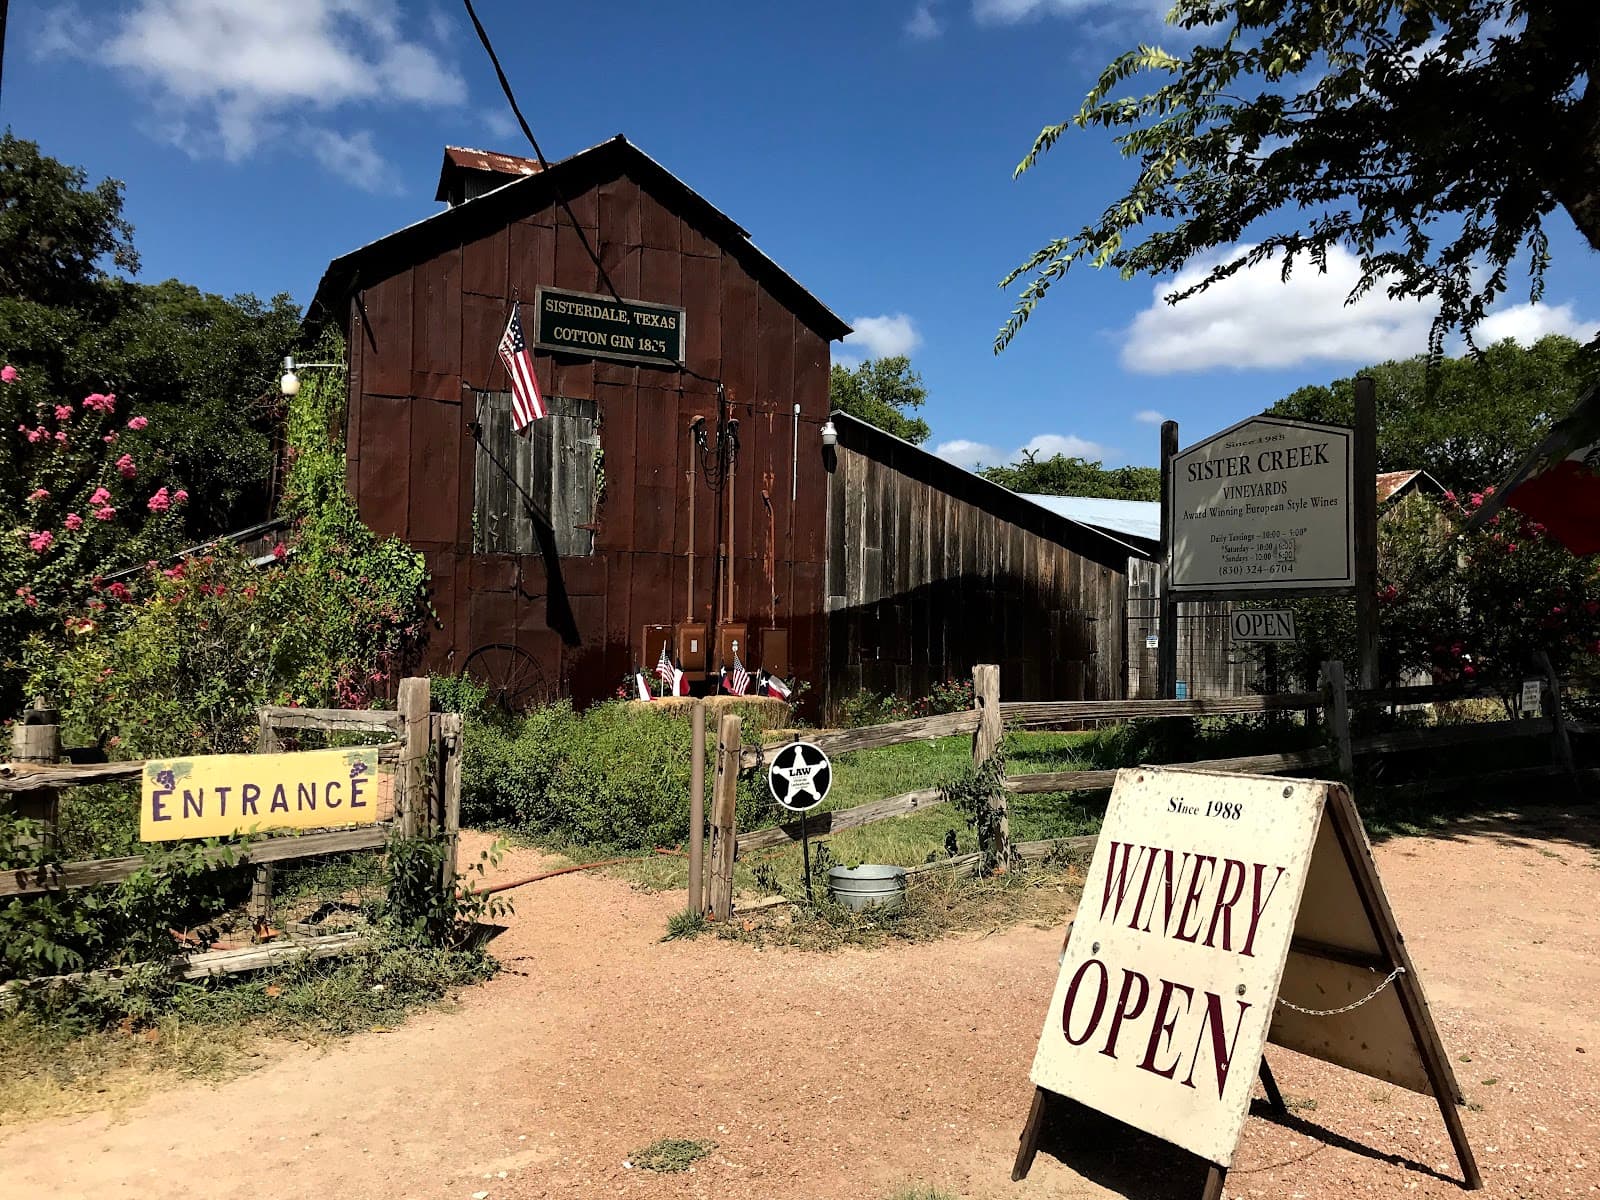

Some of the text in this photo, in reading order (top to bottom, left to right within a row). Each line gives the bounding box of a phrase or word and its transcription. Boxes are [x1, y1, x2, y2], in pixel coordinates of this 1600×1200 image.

[545, 298, 676, 330] SISTERDALE, TEXAS
[553, 326, 608, 346] COTTON
[610, 334, 635, 349] GIN
[1225, 439, 1255, 449] Since
[1187, 443, 1330, 483] SISTER CREEK
[1223, 480, 1288, 500] VINEYARDS
[1182, 496, 1338, 521] Award Winning European Style Wines
[1235, 612, 1291, 637] OPEN
[789, 767, 811, 777] LAW
[151, 777, 369, 822] ENTRANCE
[1166, 796, 1244, 822] Since 1988
[1098, 840, 1287, 958] WINERY
[1061, 958, 1253, 1102] OPEN
